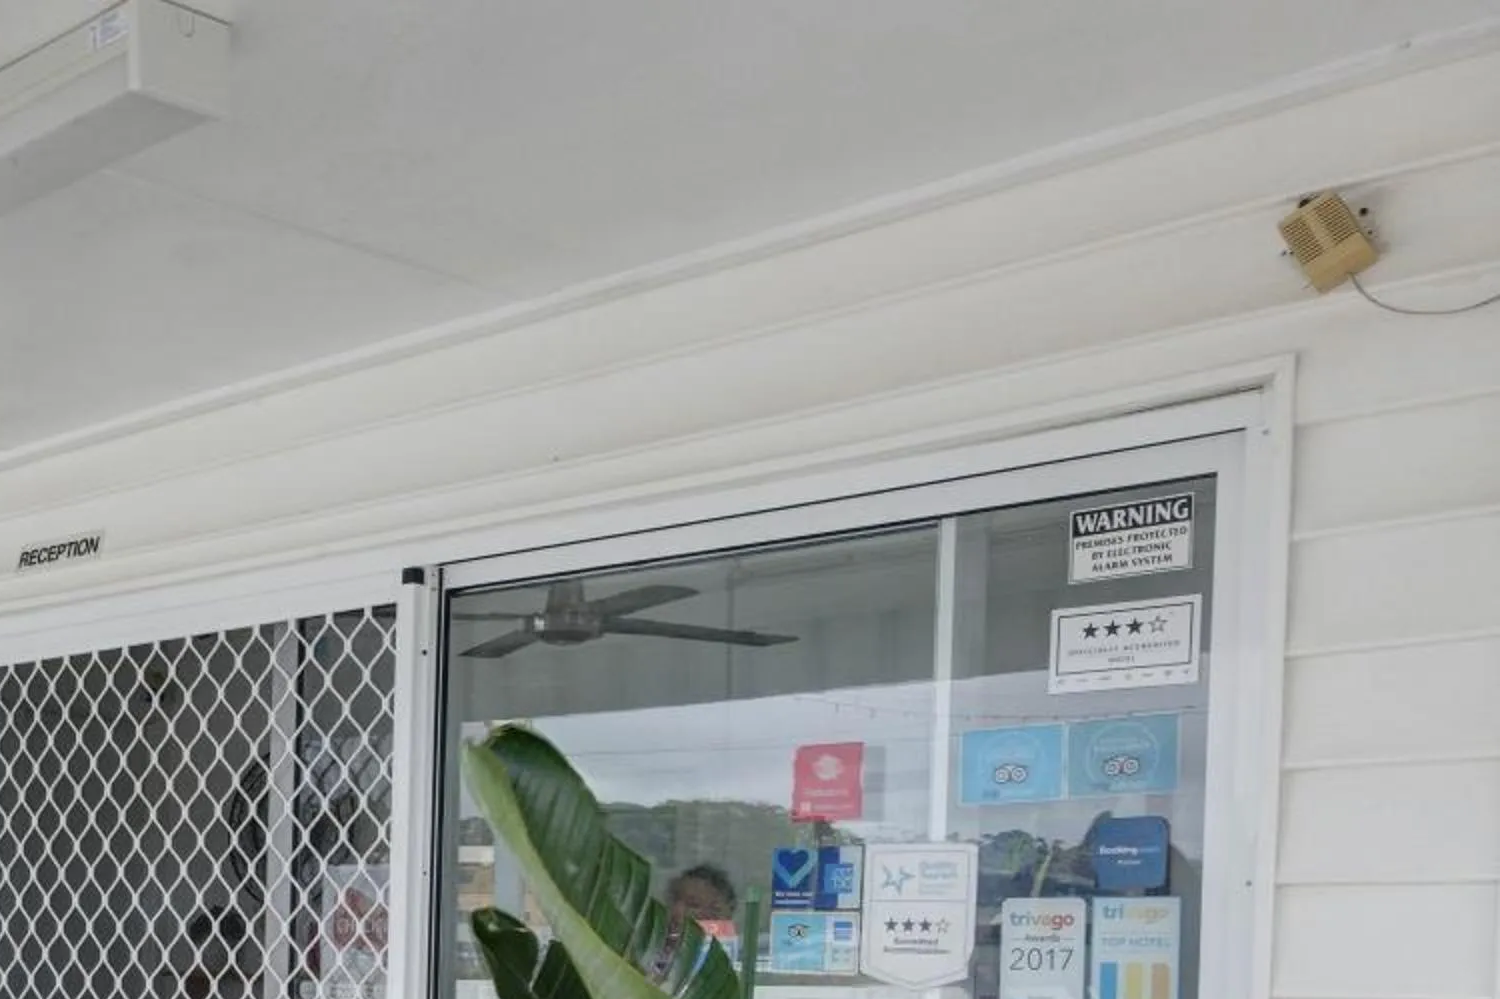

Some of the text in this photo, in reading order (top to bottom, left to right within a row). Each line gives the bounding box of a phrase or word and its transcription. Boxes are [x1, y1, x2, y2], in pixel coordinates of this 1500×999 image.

[1075, 498, 1189, 535] WARNING
[1075, 526, 1188, 550] PREMISES PROTECTED
[19, 536, 101, 568] RECEPTION
[1091, 541, 1173, 560] BY ELECTRONIC
[1092, 554, 1174, 573] ALARM SYSTEM
[1009, 911, 1075, 931] trivago
[1100, 937, 1171, 948] TOP HOTEL
[1009, 947, 1075, 971] 2017
